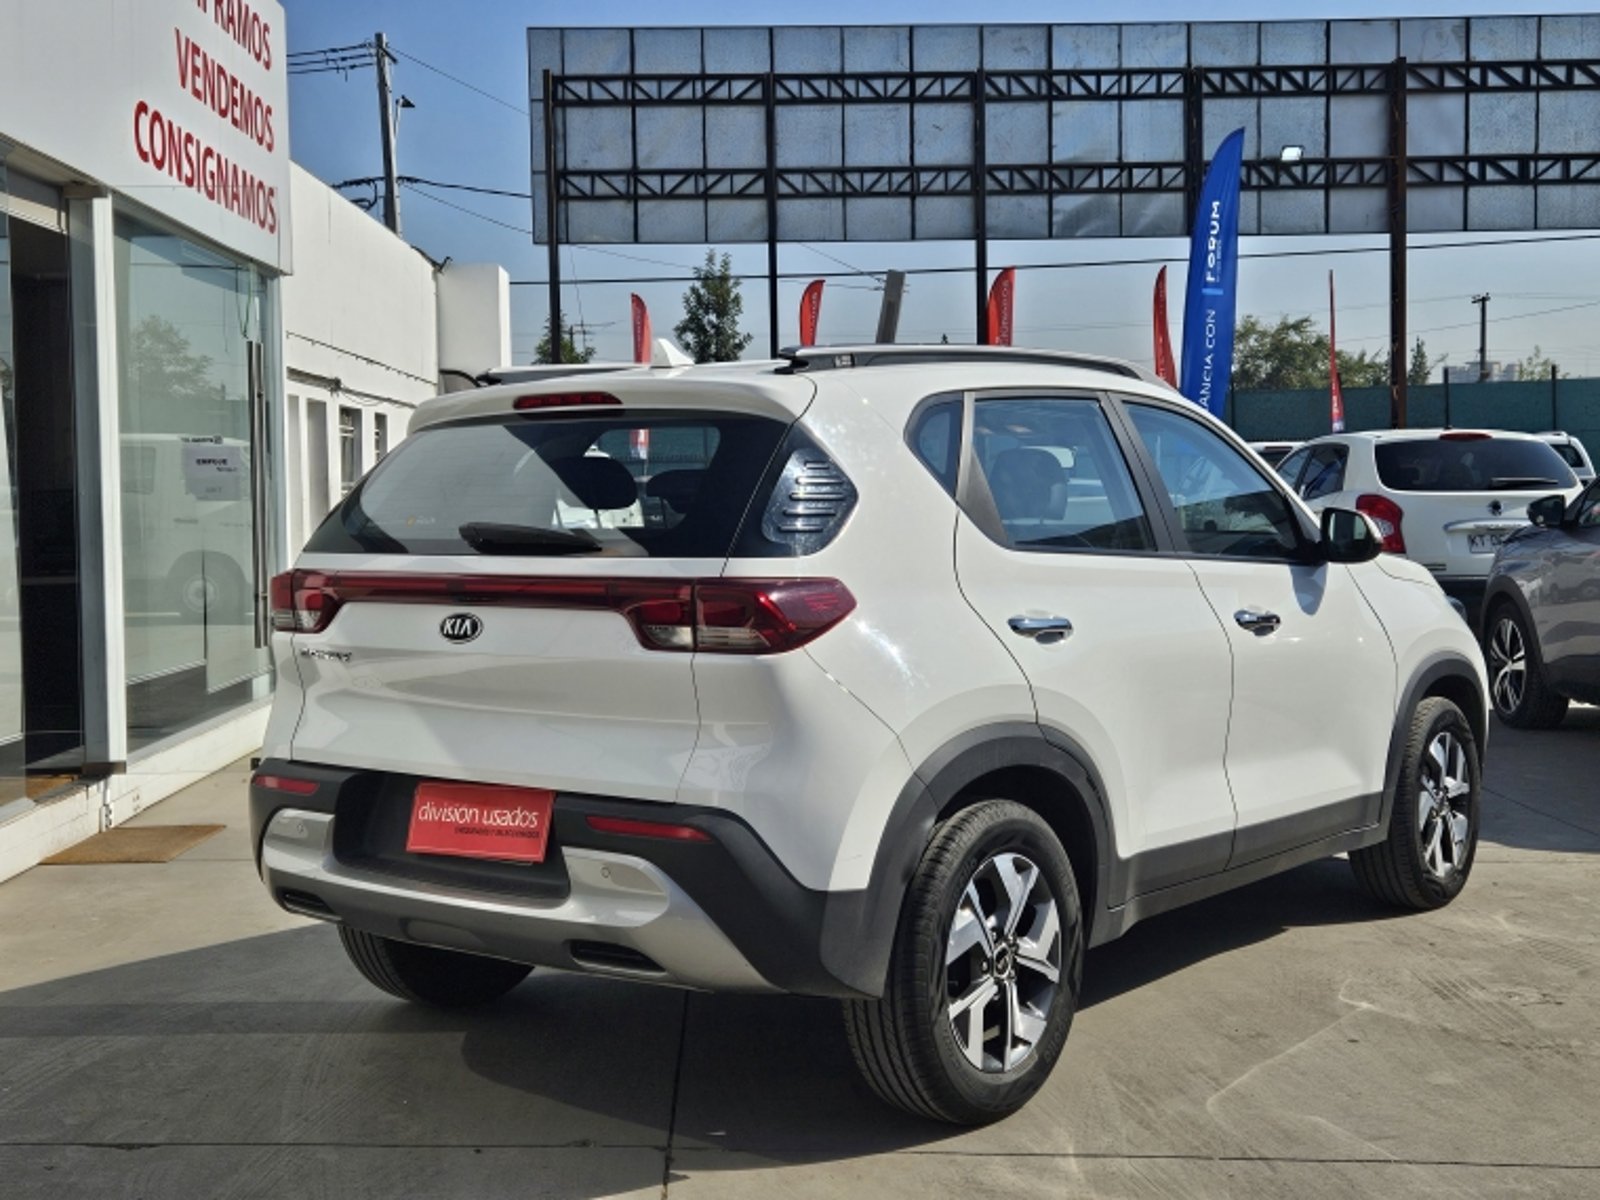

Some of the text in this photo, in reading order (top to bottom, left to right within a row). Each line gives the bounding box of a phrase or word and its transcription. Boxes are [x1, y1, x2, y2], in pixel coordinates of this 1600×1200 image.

[174, 26, 274, 153] VENDEMOS
[134, 101, 277, 234] CONSIGNAMOS
[1206, 201, 1220, 282] FORUM
[1205, 309, 1216, 349] CON
[1199, 353, 1214, 411] ANCIA
[481, 806, 539, 829] usados
